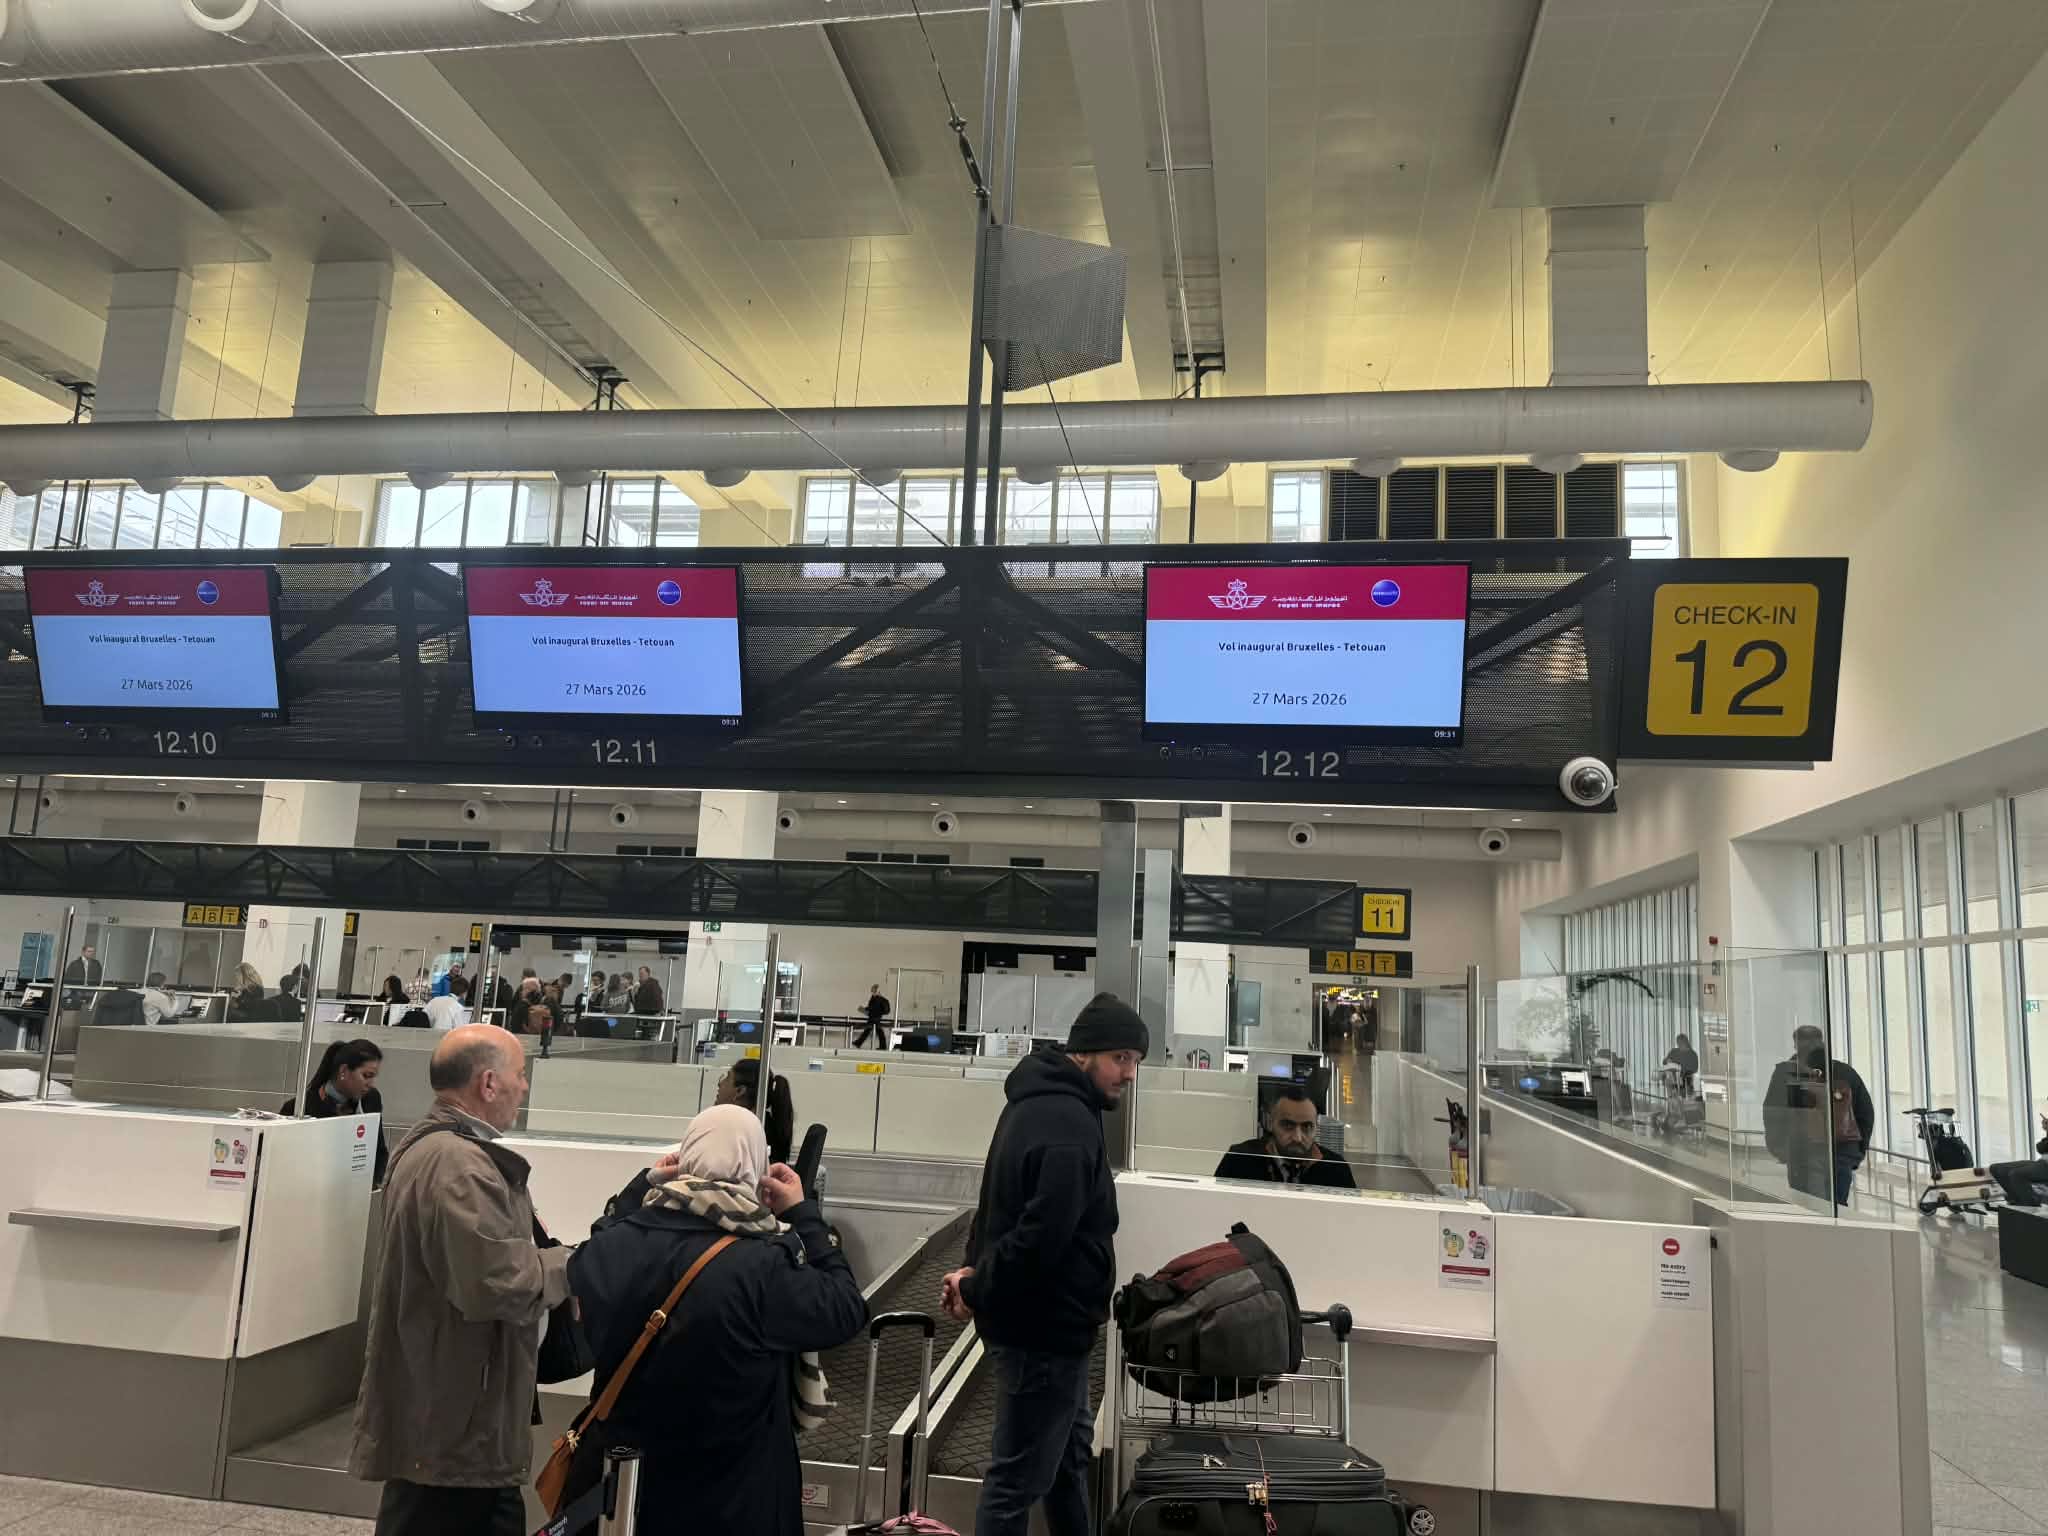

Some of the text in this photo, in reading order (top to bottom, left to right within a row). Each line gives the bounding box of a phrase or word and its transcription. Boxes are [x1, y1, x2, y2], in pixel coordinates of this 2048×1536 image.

[1674, 605, 1796, 625] CHECK-IN
[89, 634, 103, 643] Vol
[104, 634, 140, 645] inaugural
[141, 635, 177, 643] Bruxelles
[183, 635, 216, 643] Tetouan
[532, 636, 547, 645] Vol
[549, 636, 589, 647] inaugural
[591, 637, 631, 646] Bruxelles
[639, 637, 675, 646] Tetouan
[1218, 641, 1236, 651] Vol
[1238, 641, 1284, 653] inaugural
[1287, 642, 1335, 652] Bruxelles
[1344, 642, 1386, 652] Tetouan
[1675, 639, 1788, 716] 12
[121, 679, 193, 691] 27 Mars 2026
[566, 683, 647, 696] 27 Mars 2026
[1252, 692, 1347, 706] 27 Mars 2026
[153, 731, 217, 755] 12.10
[591, 739, 656, 764] 12.11
[1257, 750, 1340, 777] 12.12
[191, 911, 235, 922] A B T
[1370, 907, 1394, 928] 11
[1332, 958, 1341, 969] A
[1381, 960, 1390, 972] T
